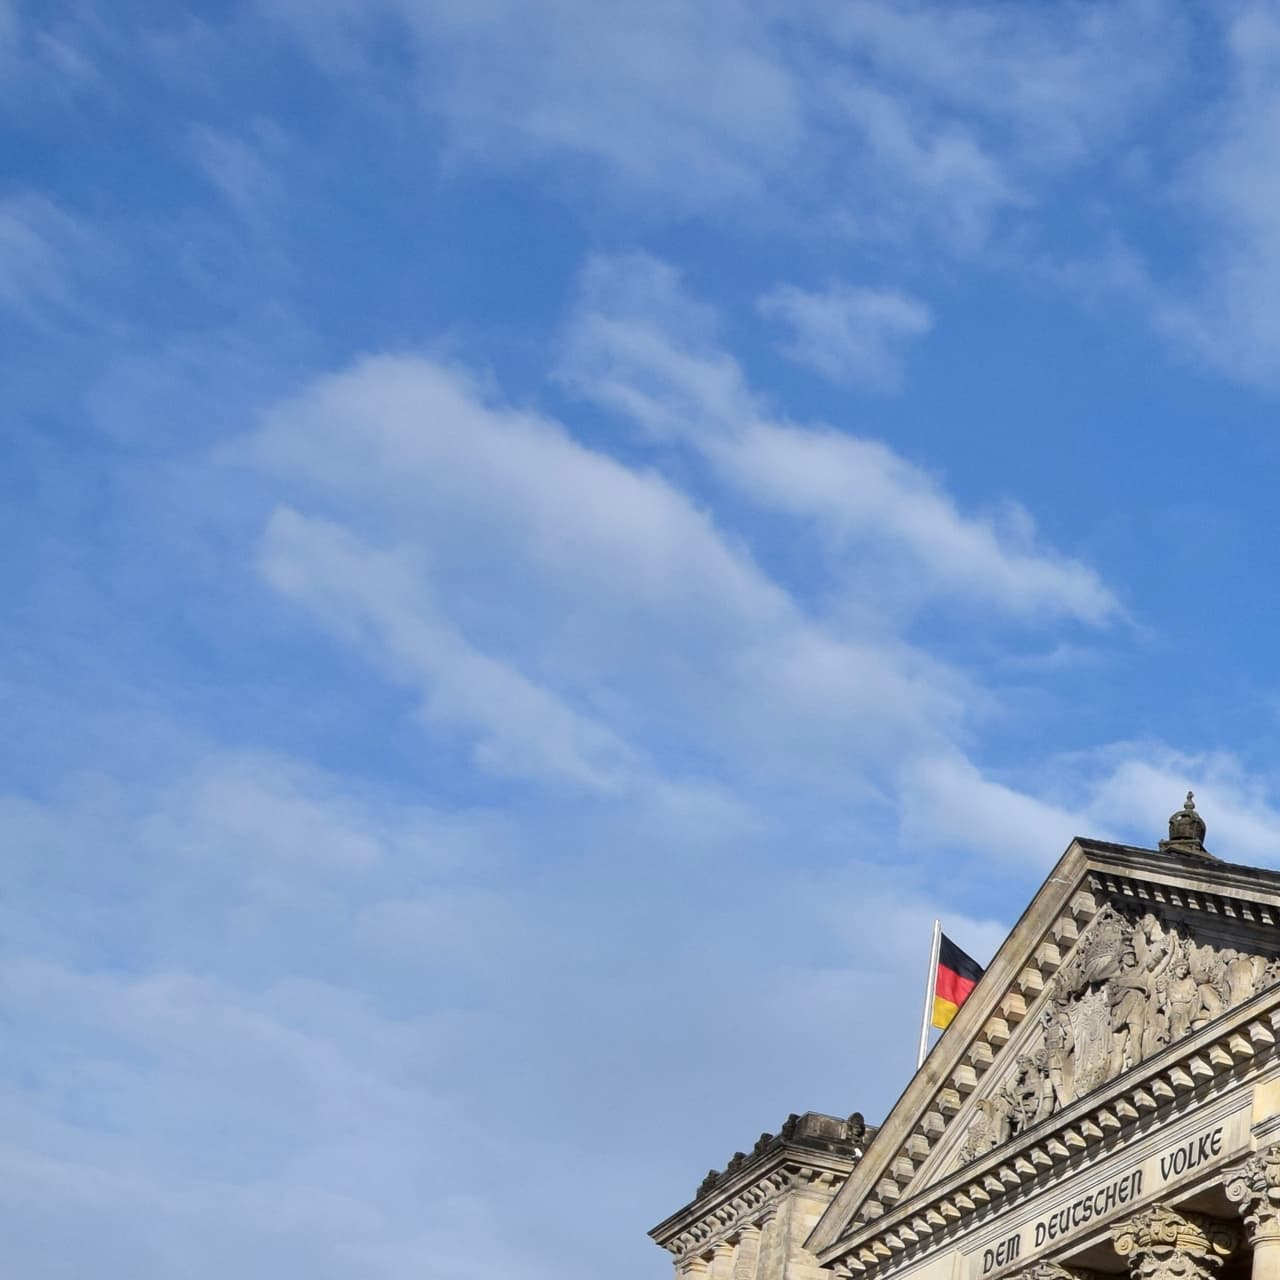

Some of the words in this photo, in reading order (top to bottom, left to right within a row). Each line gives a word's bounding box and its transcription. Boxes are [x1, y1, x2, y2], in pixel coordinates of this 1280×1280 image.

[983, 1234, 1020, 1273] DEM
[1035, 1170, 1142, 1247] DEUTSCHEN
[1161, 1128, 1222, 1180] VOLKE
